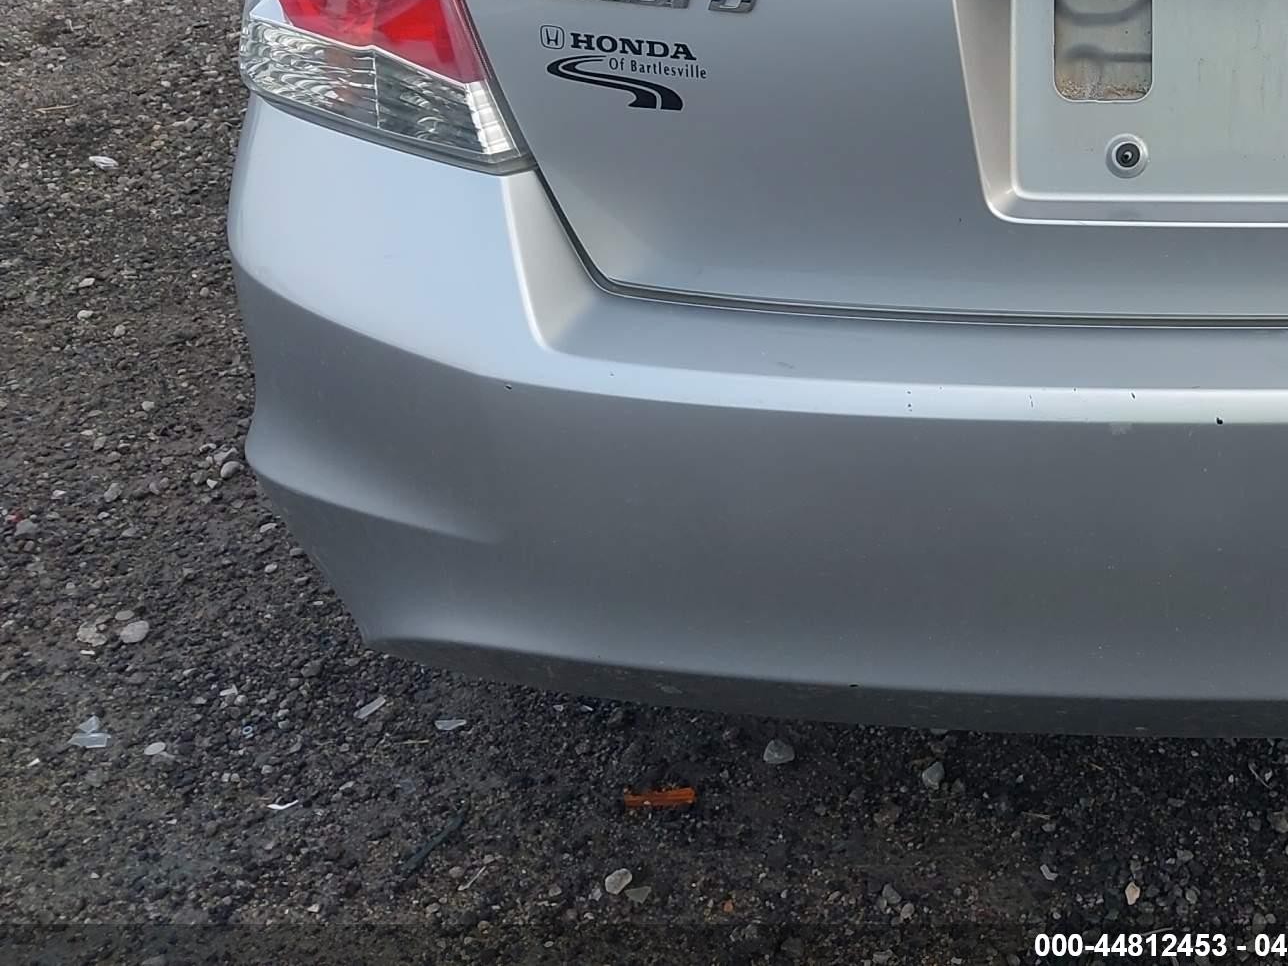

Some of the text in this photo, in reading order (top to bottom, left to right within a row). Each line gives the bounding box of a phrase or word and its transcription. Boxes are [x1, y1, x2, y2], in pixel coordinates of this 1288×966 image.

[570, 32, 697, 61] HONDA
[608, 57, 707, 79] Of Bartlesville
